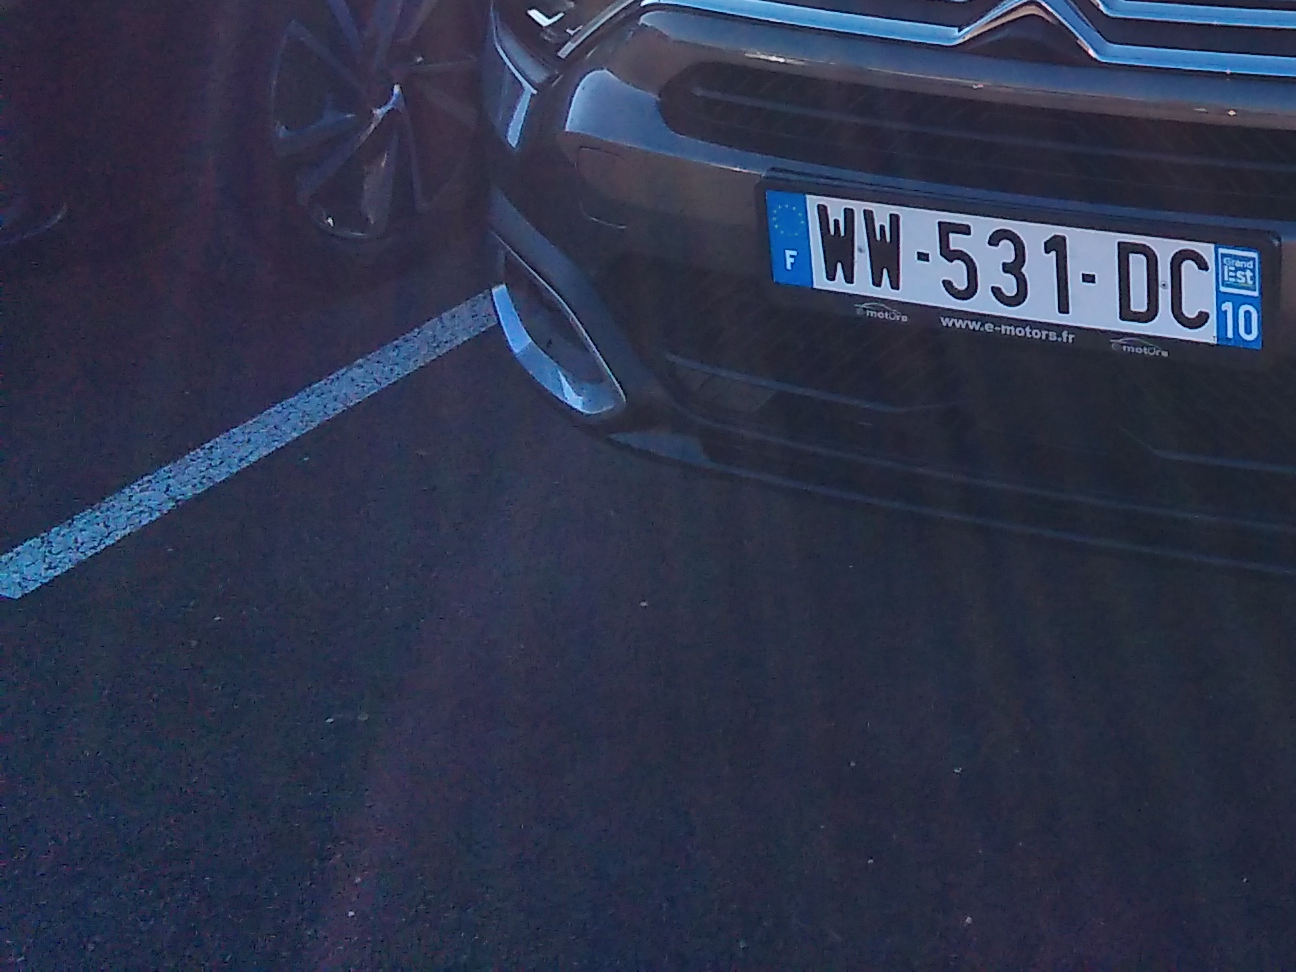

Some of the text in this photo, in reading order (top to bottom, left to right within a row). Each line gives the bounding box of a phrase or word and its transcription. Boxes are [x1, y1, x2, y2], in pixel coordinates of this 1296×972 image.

[784, 249, 798, 271] F
[817, 203, 1211, 330] WW-531-DC
[1223, 257, 1254, 269] Grand
[1223, 266, 1254, 285] Est
[940, 315, 1076, 344] www.e-motors.fr
[1221, 301, 1259, 342] 10
